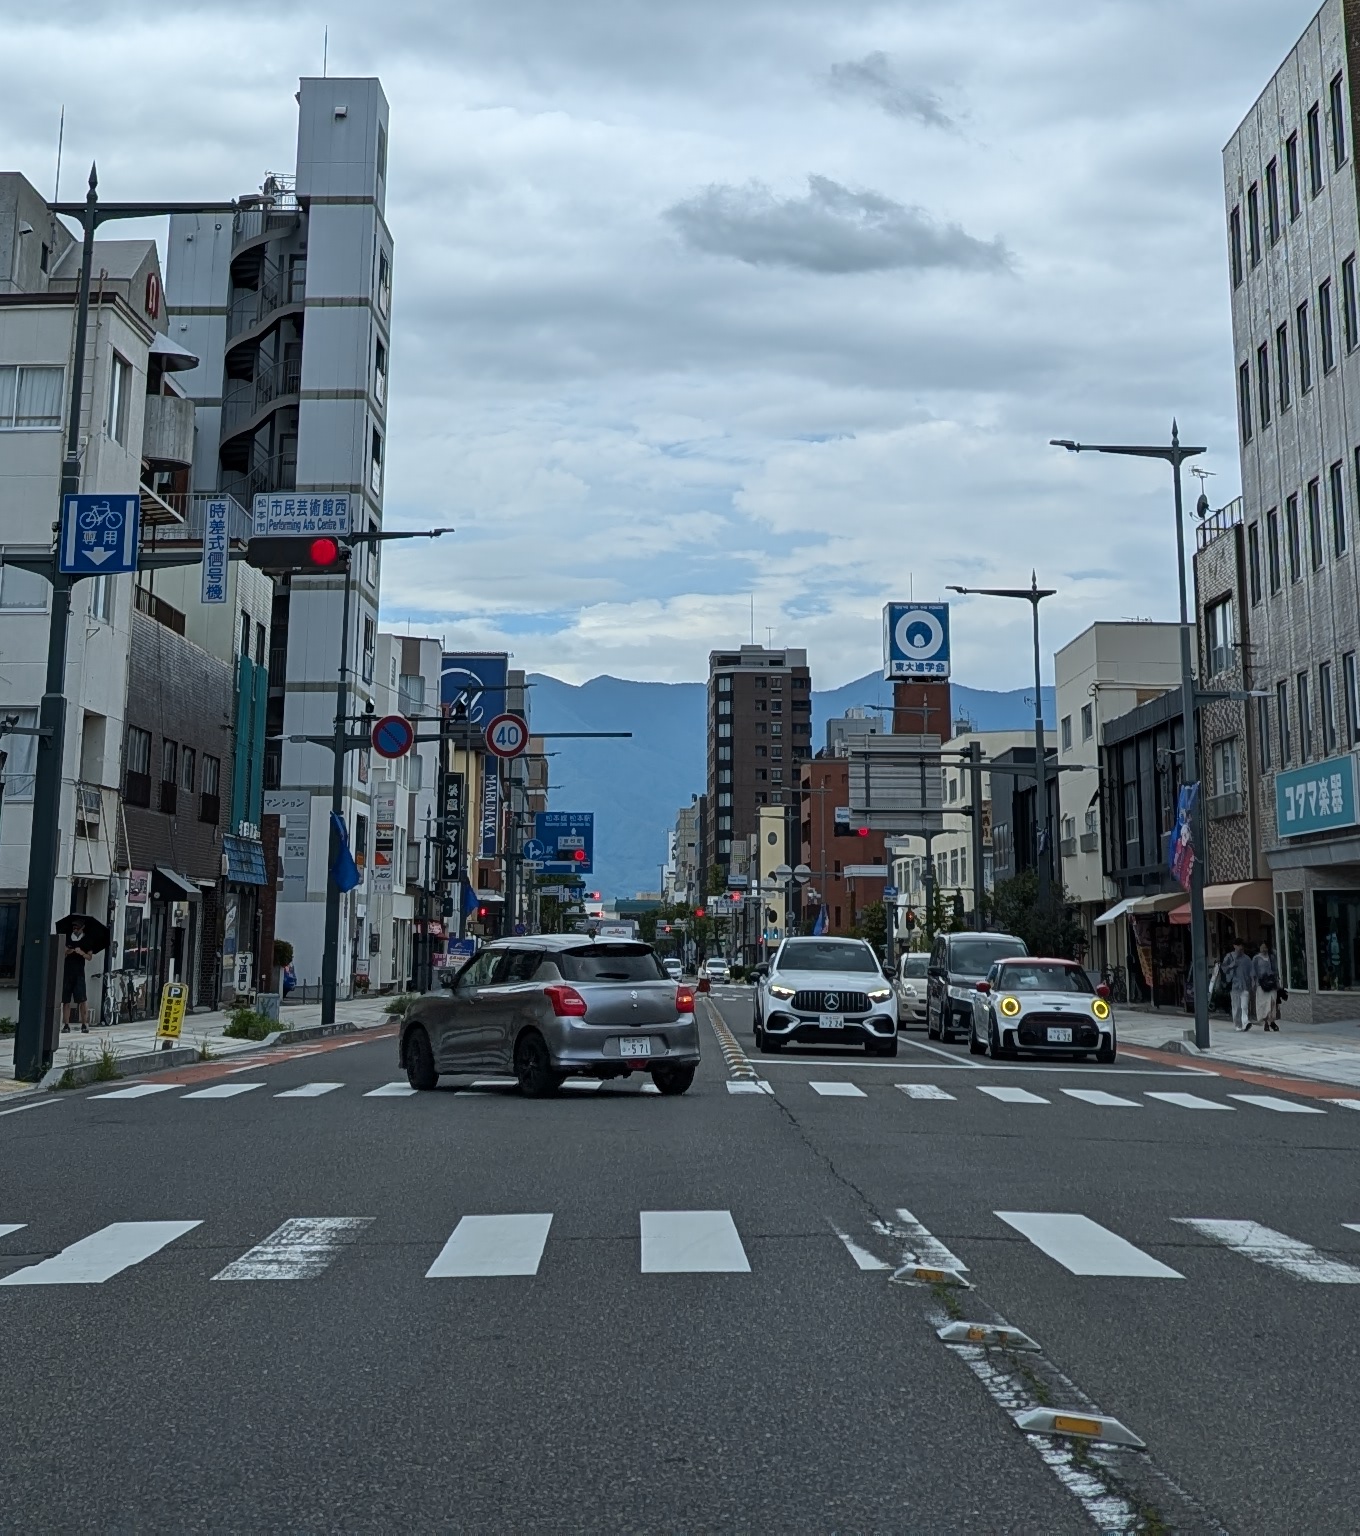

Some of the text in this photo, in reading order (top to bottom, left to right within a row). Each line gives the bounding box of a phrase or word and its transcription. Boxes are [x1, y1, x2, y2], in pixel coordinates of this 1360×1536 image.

[271, 498, 347, 517] 市民芸術館西
[268, 518, 301, 532] Performing
[303, 518, 316, 531] Arts
[317, 518, 337, 531] Centre
[82, 530, 117, 546] 専用
[205, 502, 227, 600] 時差式信号機
[895, 662, 945, 672] 東大進学会
[496, 726, 519, 745] 40
[265, 798, 304, 808] マンション
[484, 775, 496, 838] MARUNAKA
[171, 987, 181, 997] P
